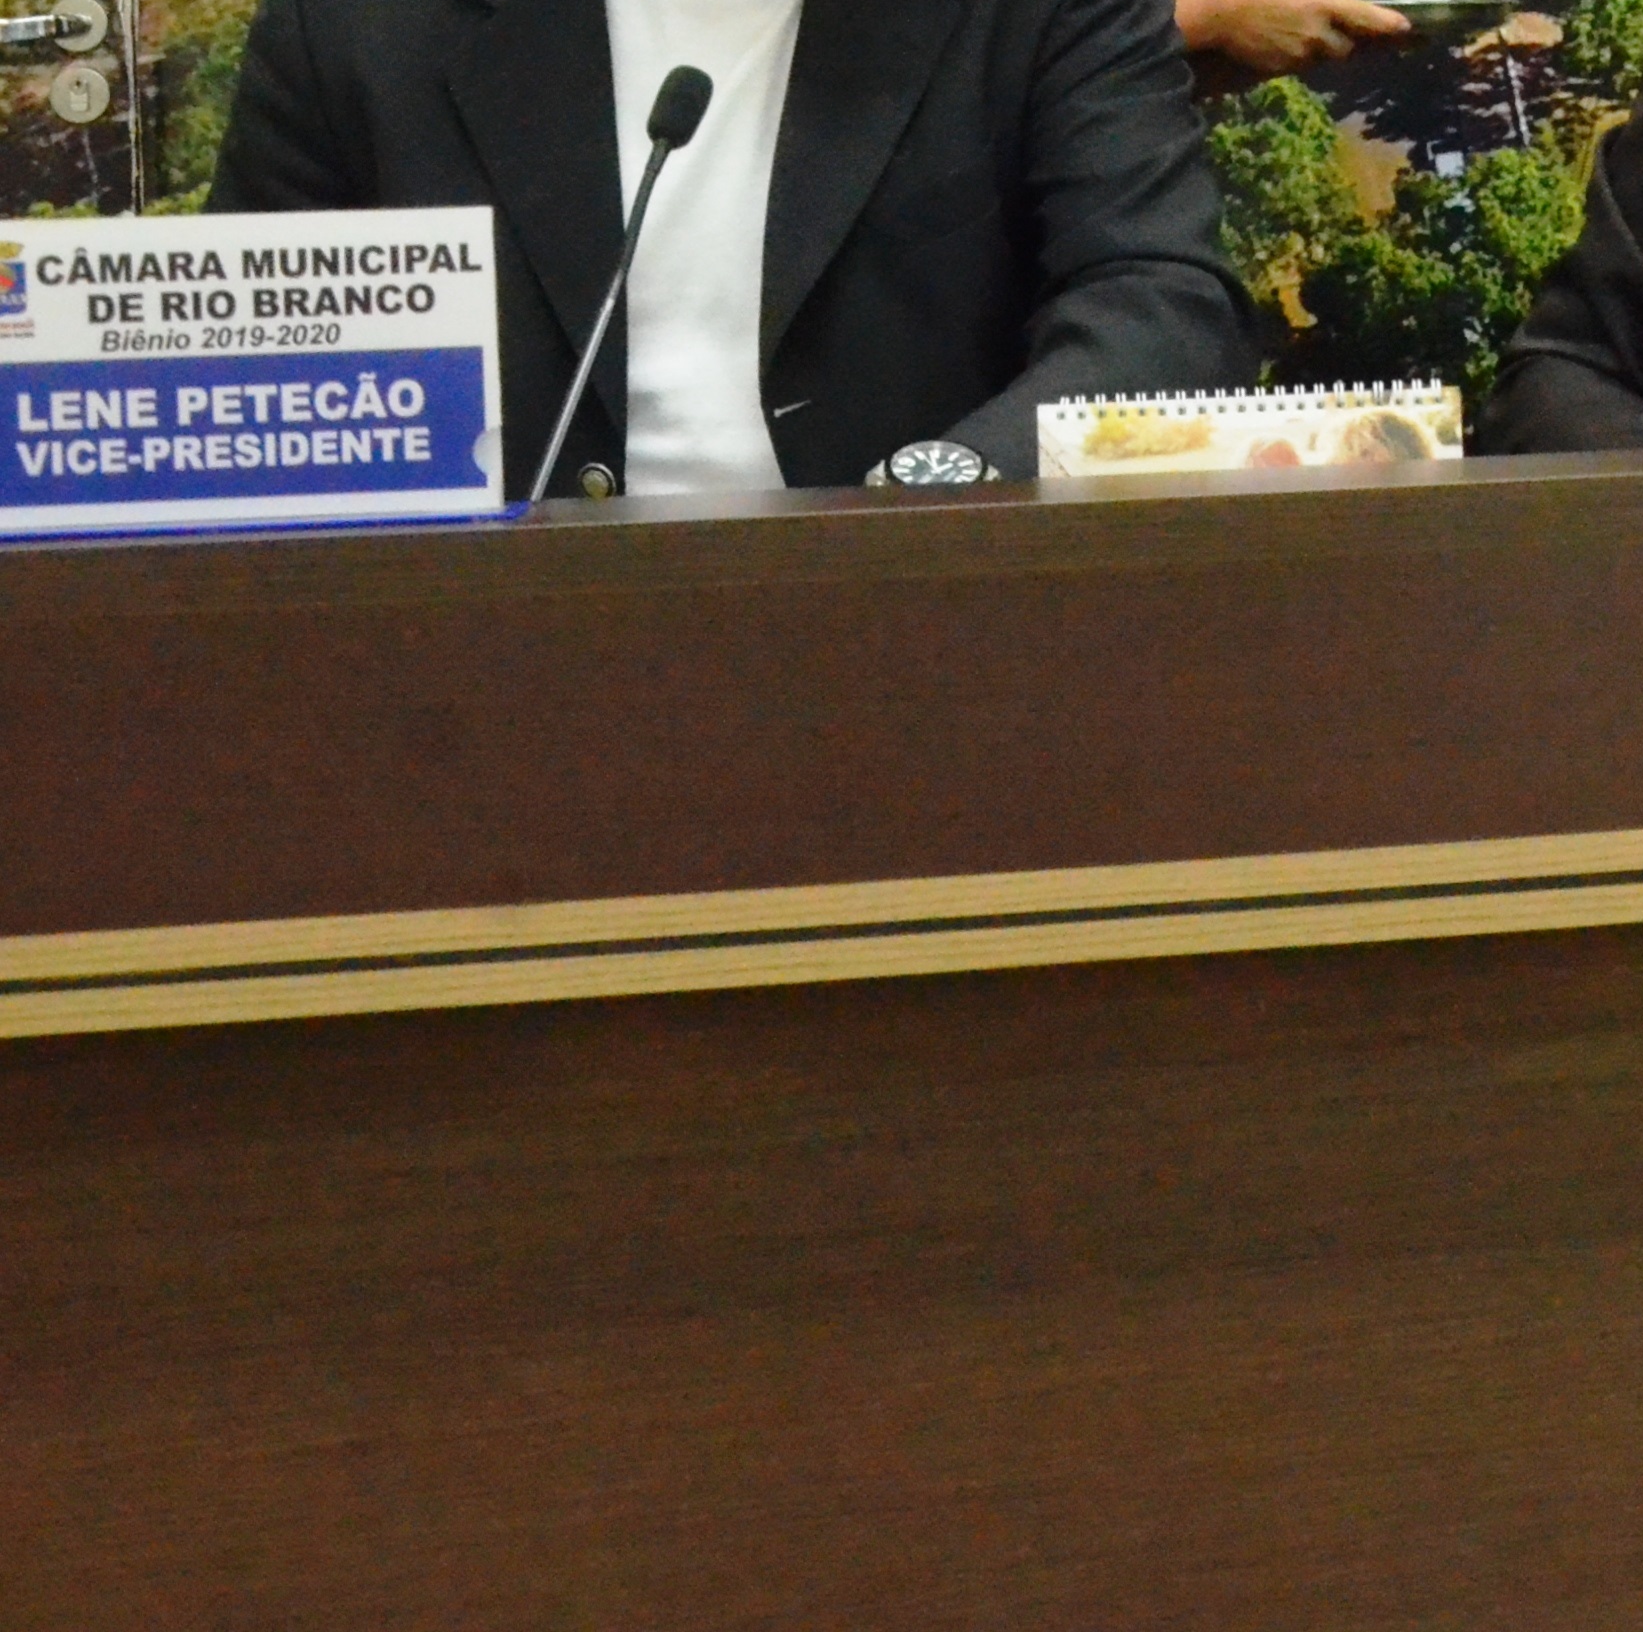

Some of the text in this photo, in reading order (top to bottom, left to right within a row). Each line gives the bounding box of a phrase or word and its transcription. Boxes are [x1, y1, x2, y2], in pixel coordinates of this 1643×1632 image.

[36, 243, 482, 286] CÂMARA MUNICIPAL
[87, 284, 435, 324] DE RIO BRANCO
[100, 323, 341, 353] Biênio 2019-2020
[16, 371, 426, 432] LENE PETECÃO
[16, 427, 432, 477] VICE-PRESIDENTE
